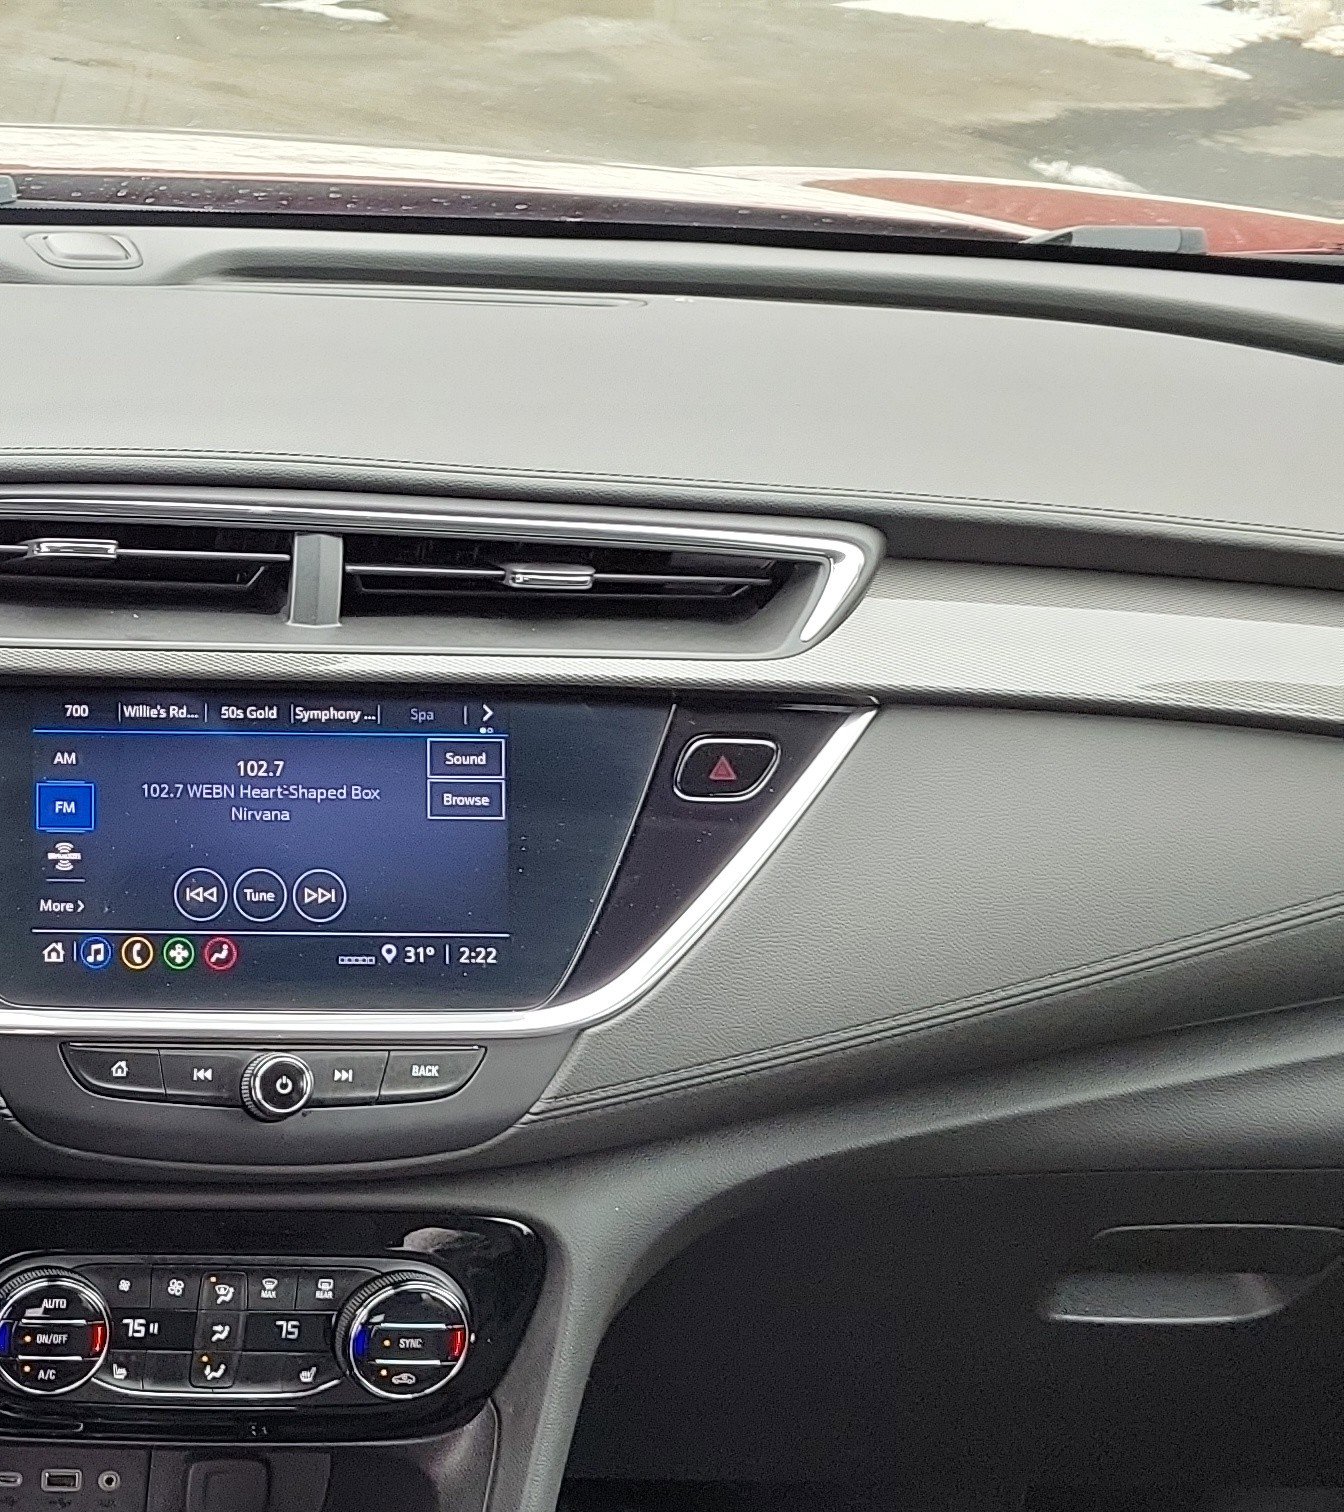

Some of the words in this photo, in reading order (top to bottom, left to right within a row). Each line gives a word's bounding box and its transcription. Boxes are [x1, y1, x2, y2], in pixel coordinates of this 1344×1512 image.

[64, 705, 89, 717] 700
[123, 705, 167, 718] Willie's
[220, 706, 244, 719] 50s
[246, 706, 278, 719] Gold
[295, 706, 362, 723] Symphony
[410, 708, 434, 723] Spa
[53, 752, 77, 765] AM
[445, 752, 487, 765] Sound
[237, 760, 285, 777] 102.7
[141, 784, 183, 798] 102.7
[187, 784, 235, 798] WEBN
[351, 786, 381, 800] Box
[443, 793, 490, 806] Browse
[55, 801, 76, 814] FM
[231, 806, 290, 821] Nirvana
[243, 888, 275, 902] Tune
[39, 899, 74, 912] More
[459, 947, 497, 964] 2:22
[411, 1064, 439, 1077] BACK
[42, 1298, 67, 1309] AUTO
[122, 1318, 147, 1339] 75
[275, 1320, 301, 1340] 75
[36, 1333, 69, 1345] ON/OFF
[398, 1338, 423, 1349] SYNC
[37, 1369, 57, 1381] A/C
